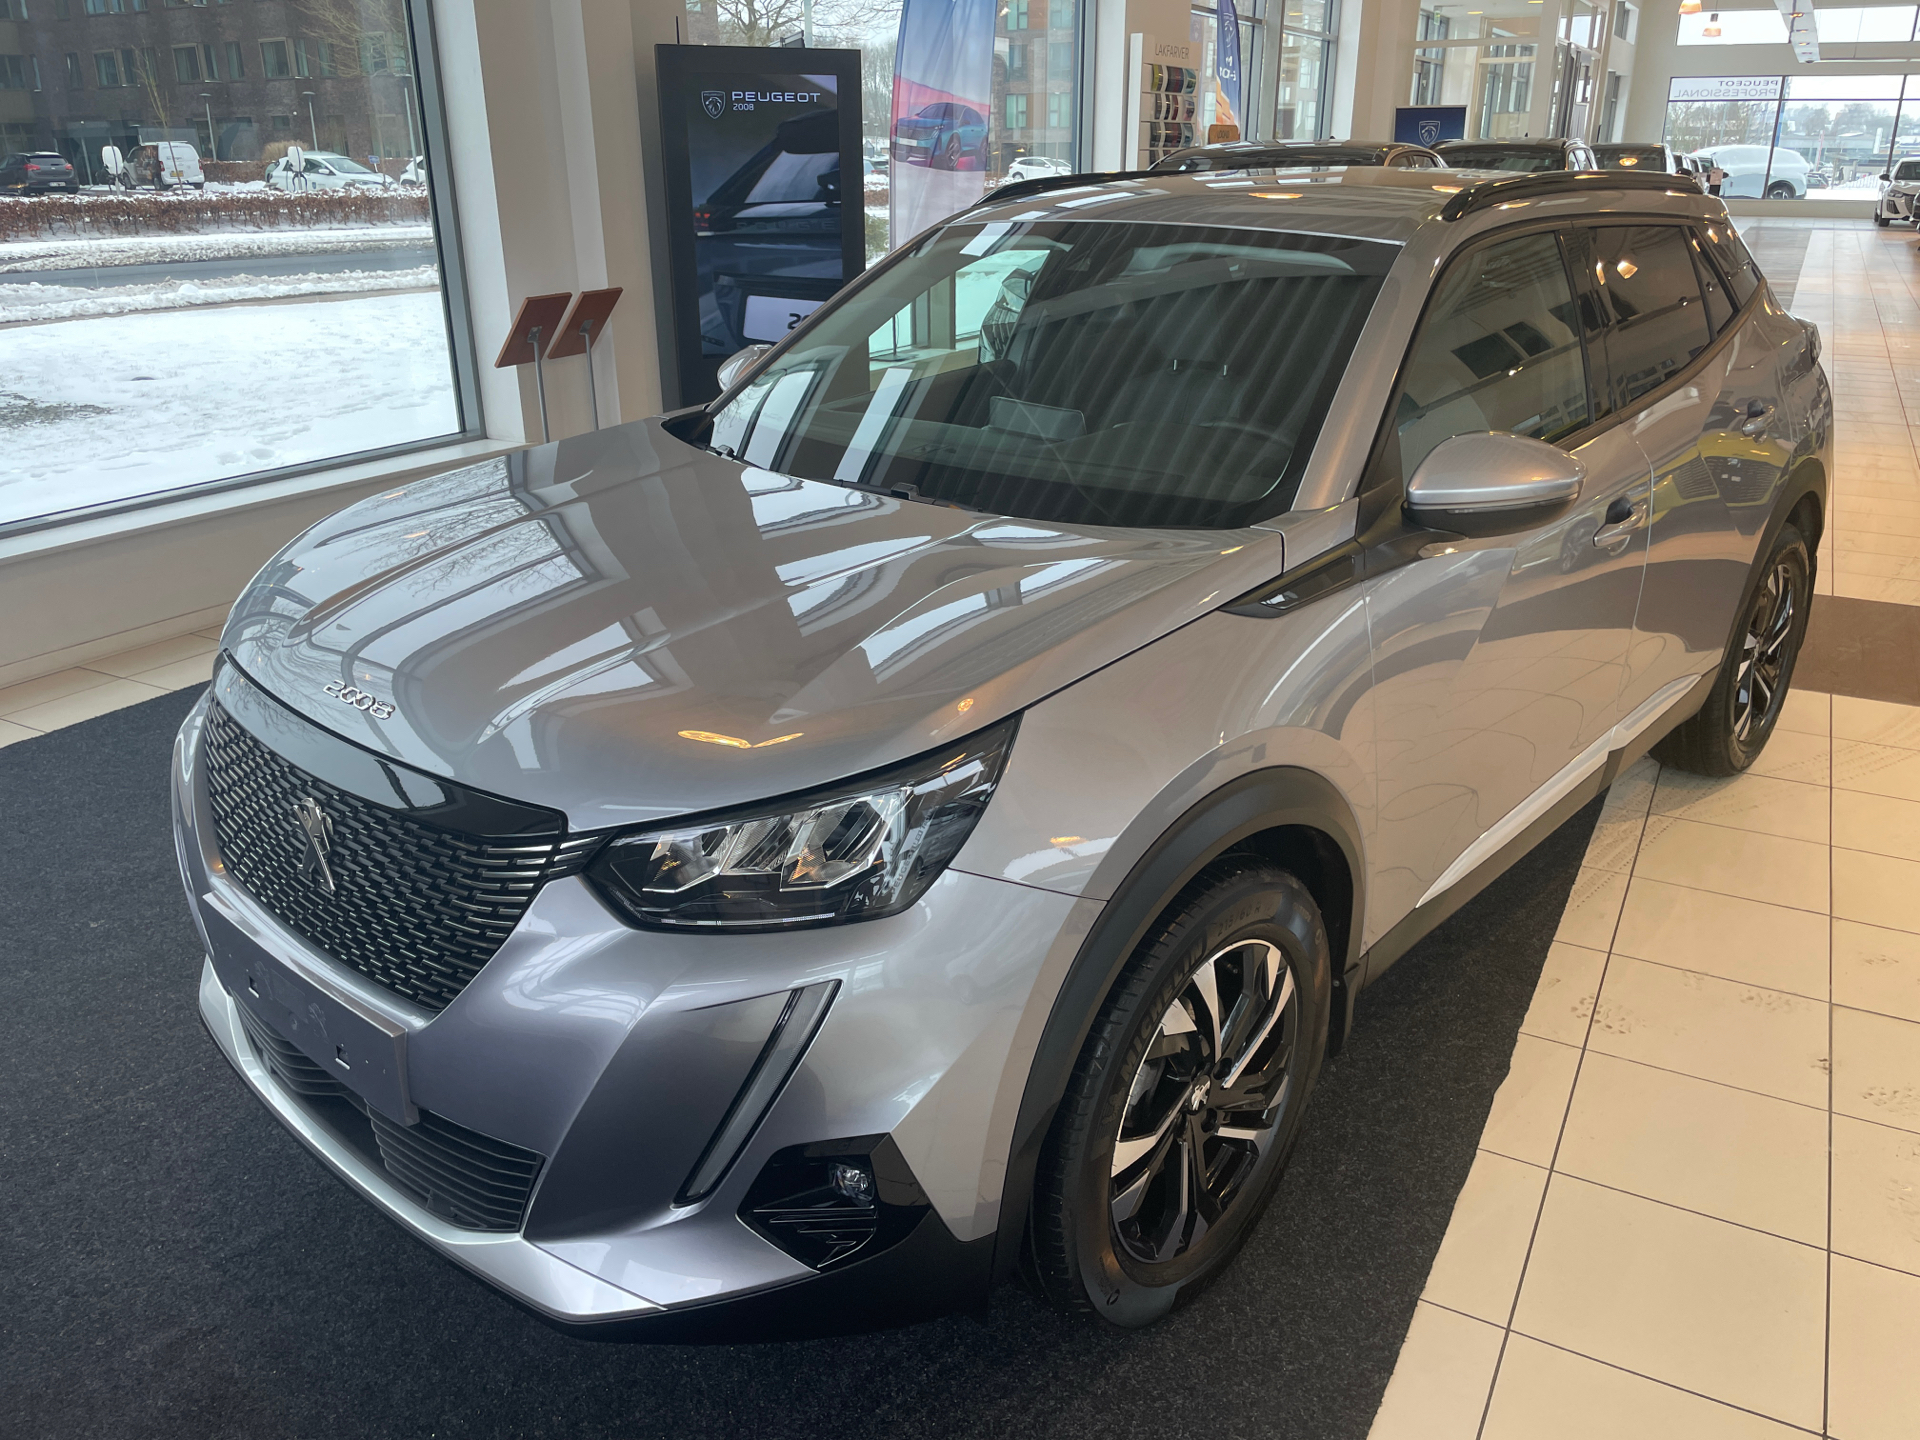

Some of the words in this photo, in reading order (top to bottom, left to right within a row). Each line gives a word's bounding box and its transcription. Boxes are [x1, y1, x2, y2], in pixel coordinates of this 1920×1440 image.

[1155, 43, 1189, 59] LAKFARVER
[731, 91, 821, 102] PEUGEOT
[733, 103, 754, 111] 2008
[322, 679, 396, 720] 2008
[1119, 934, 1204, 1083] MICHELIN
